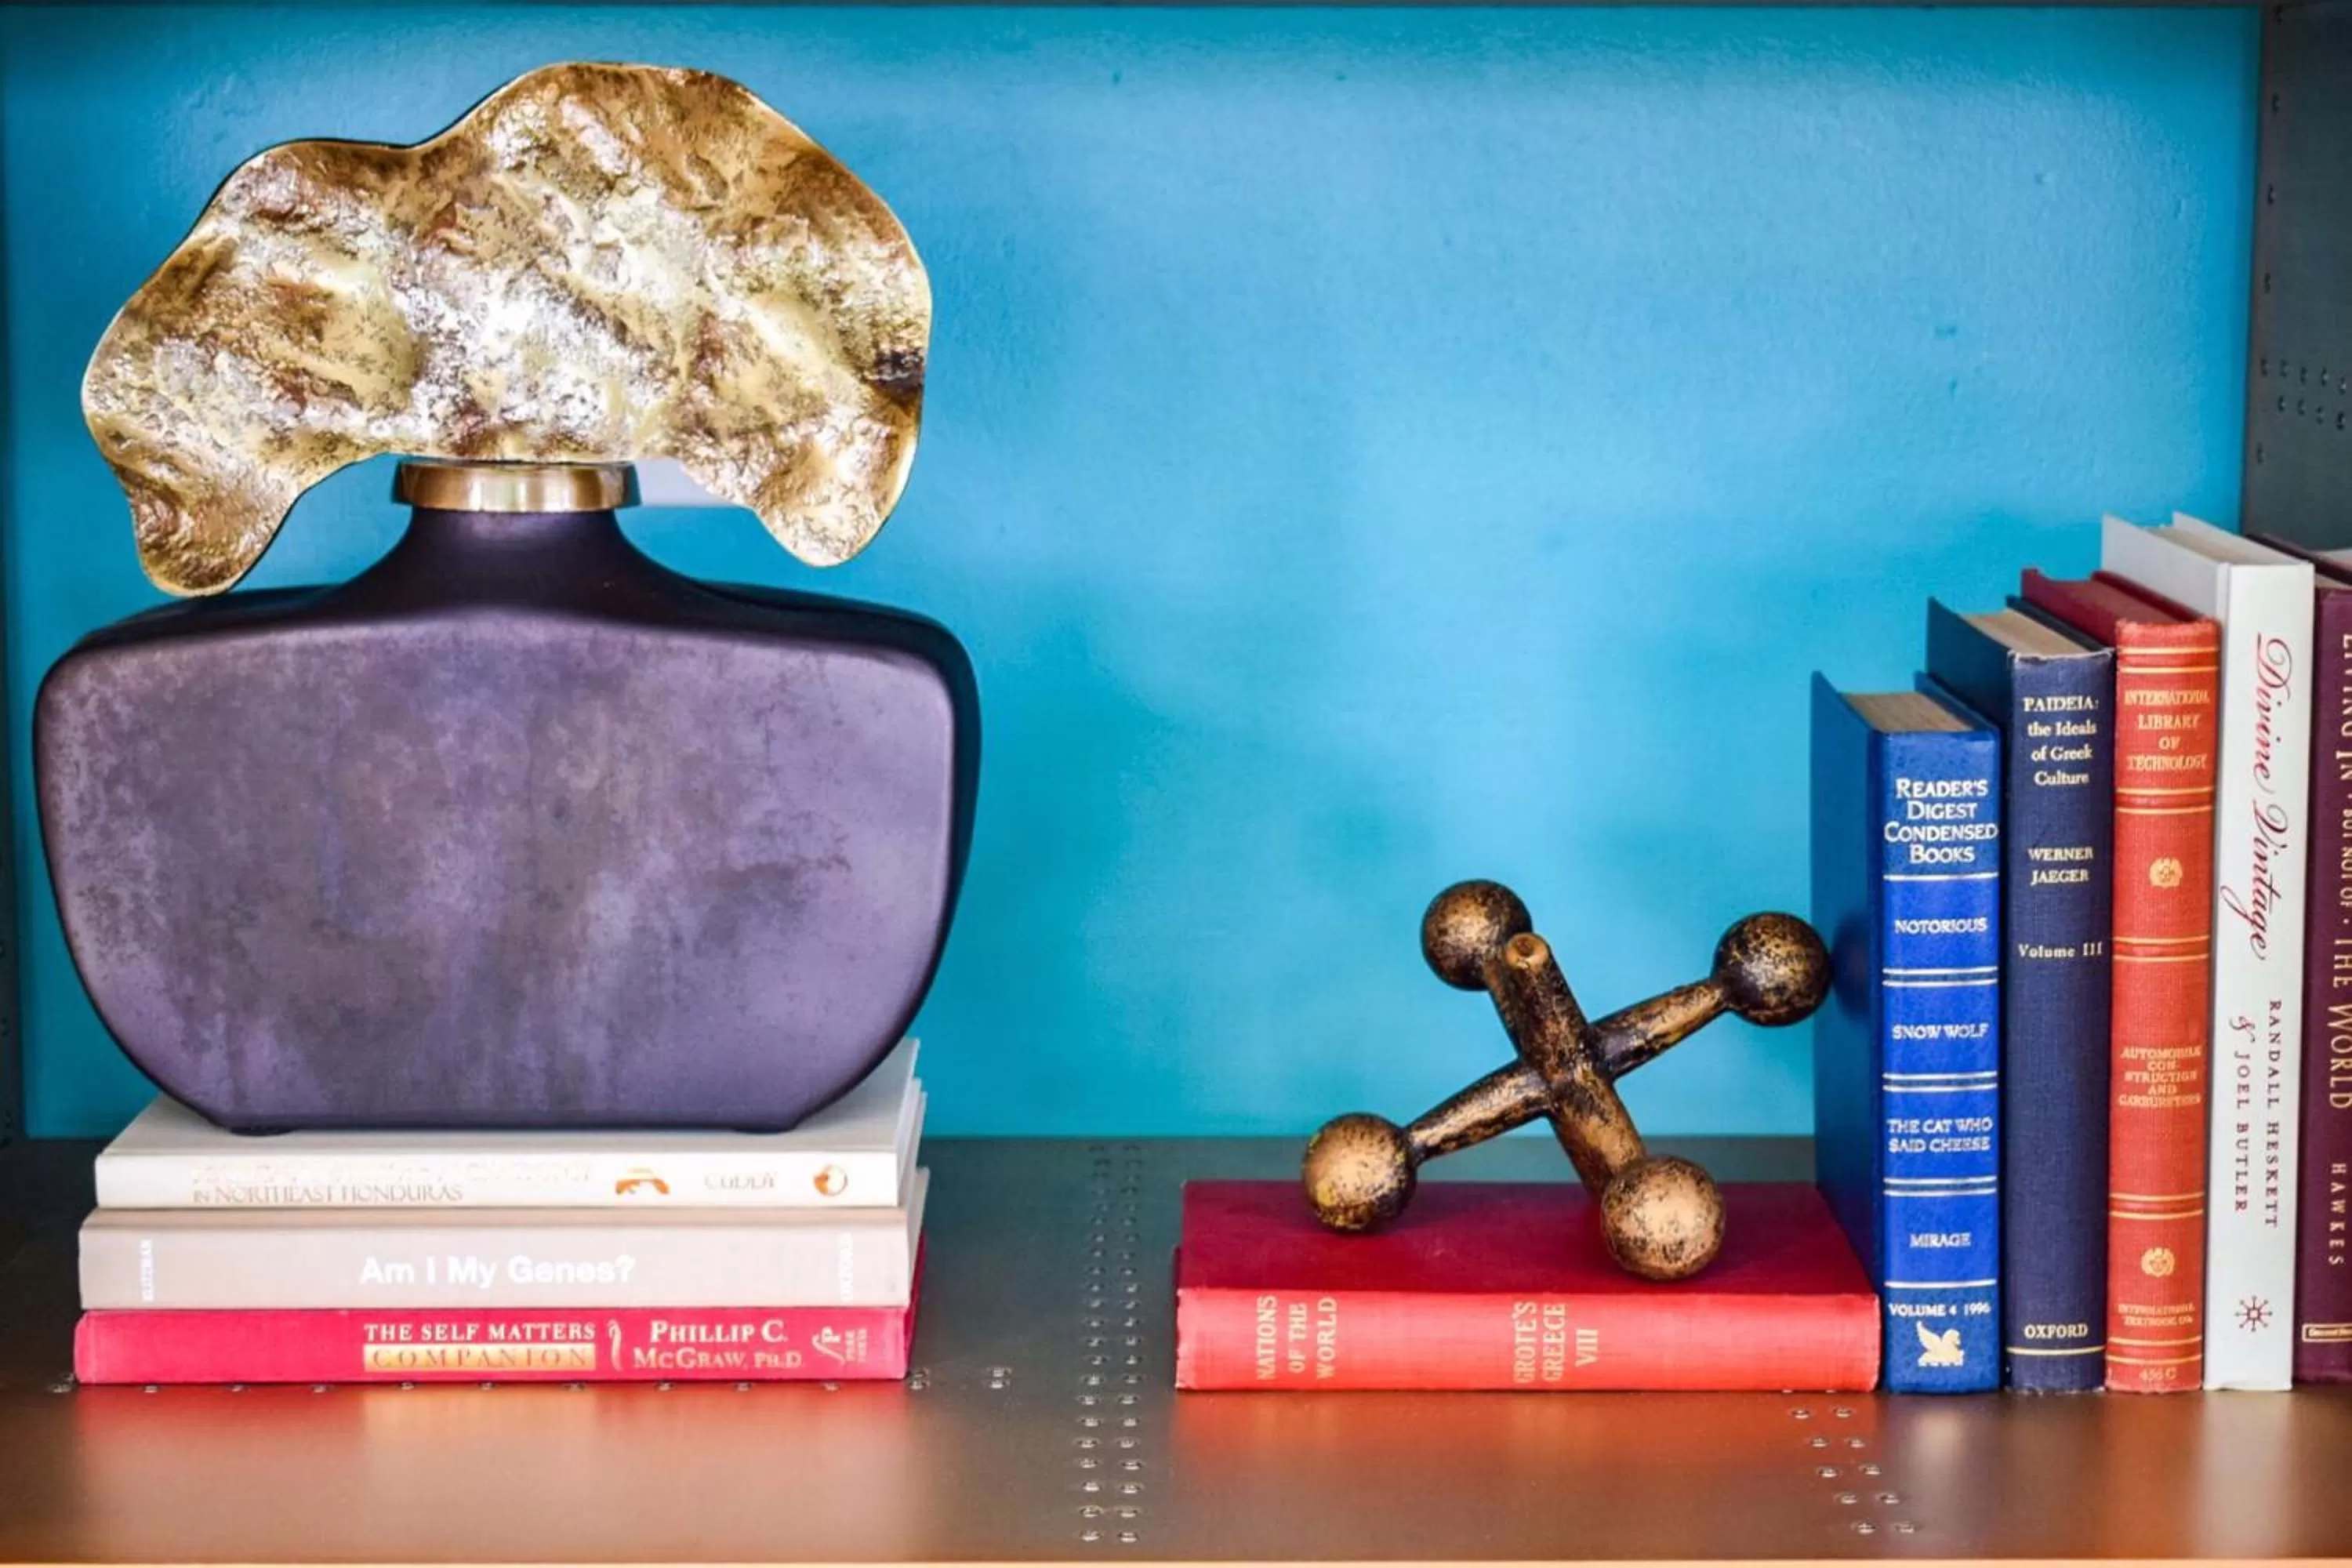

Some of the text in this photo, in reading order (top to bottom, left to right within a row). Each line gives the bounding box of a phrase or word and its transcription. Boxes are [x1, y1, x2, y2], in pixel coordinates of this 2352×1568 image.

[2027, 720, 2097, 737] the Ideals
[2138, 713, 2201, 730] LIBRARY
[2031, 744, 2092, 761] of Greek
[2125, 753, 2208, 771] TECHNOLOGY
[2034, 770, 2089, 786] Culture
[1895, 778, 1989, 799] READER'S
[2220, 633, 2292, 960] Divine Vintage
[1907, 801, 1978, 820] DIGEST
[1884, 822, 1998, 842] CONDENSED
[1909, 844, 1975, 863] BOOKS
[2027, 847, 2093, 862] WERNER
[2030, 869, 2089, 887] JAEGER
[1894, 917, 1988, 934] NOTORIOUS
[2018, 942, 2103, 958] Volume III
[1892, 1022, 1989, 1040] SNOW WOLF
[2327, 1004, 2352, 1109] WORLD
[2236, 1051, 2251, 1109] JOEL
[2147, 1085, 2177, 1095] AND
[2265, 1000, 2282, 1227] RANDALL HESKETT
[1887, 1116, 1993, 1134] THE CAT WHO
[1888, 1136, 1991, 1153] SAID CHEESE
[2235, 1123, 2249, 1212] BUTLER
[215, 1186, 336, 1203] NORTHEAST
[340, 1185, 464, 1203] HONDURAS
[2328, 1163, 2347, 1266] HAWKES
[1910, 1232, 1971, 1248] MIRAGE
[360, 1254, 636, 1289] Am I My Genes?
[1888, 1303, 1947, 1318] VOLUME
[1949, 1304, 1957, 1316] 4
[364, 1322, 596, 1341] THE SELF MATTERS
[650, 1319, 788, 1343] PHILLIP C.
[1257, 1295, 1277, 1381] NATIONS
[1288, 1302, 1308, 1374] OF THE
[1317, 1298, 1338, 1380] WORLD
[2024, 1324, 2088, 1339] OXFORD
[1512, 1301, 1537, 1384] GROTE'S
[1542, 1304, 1566, 1382] GREECE
[373, 1348, 586, 1368] COMPANION
